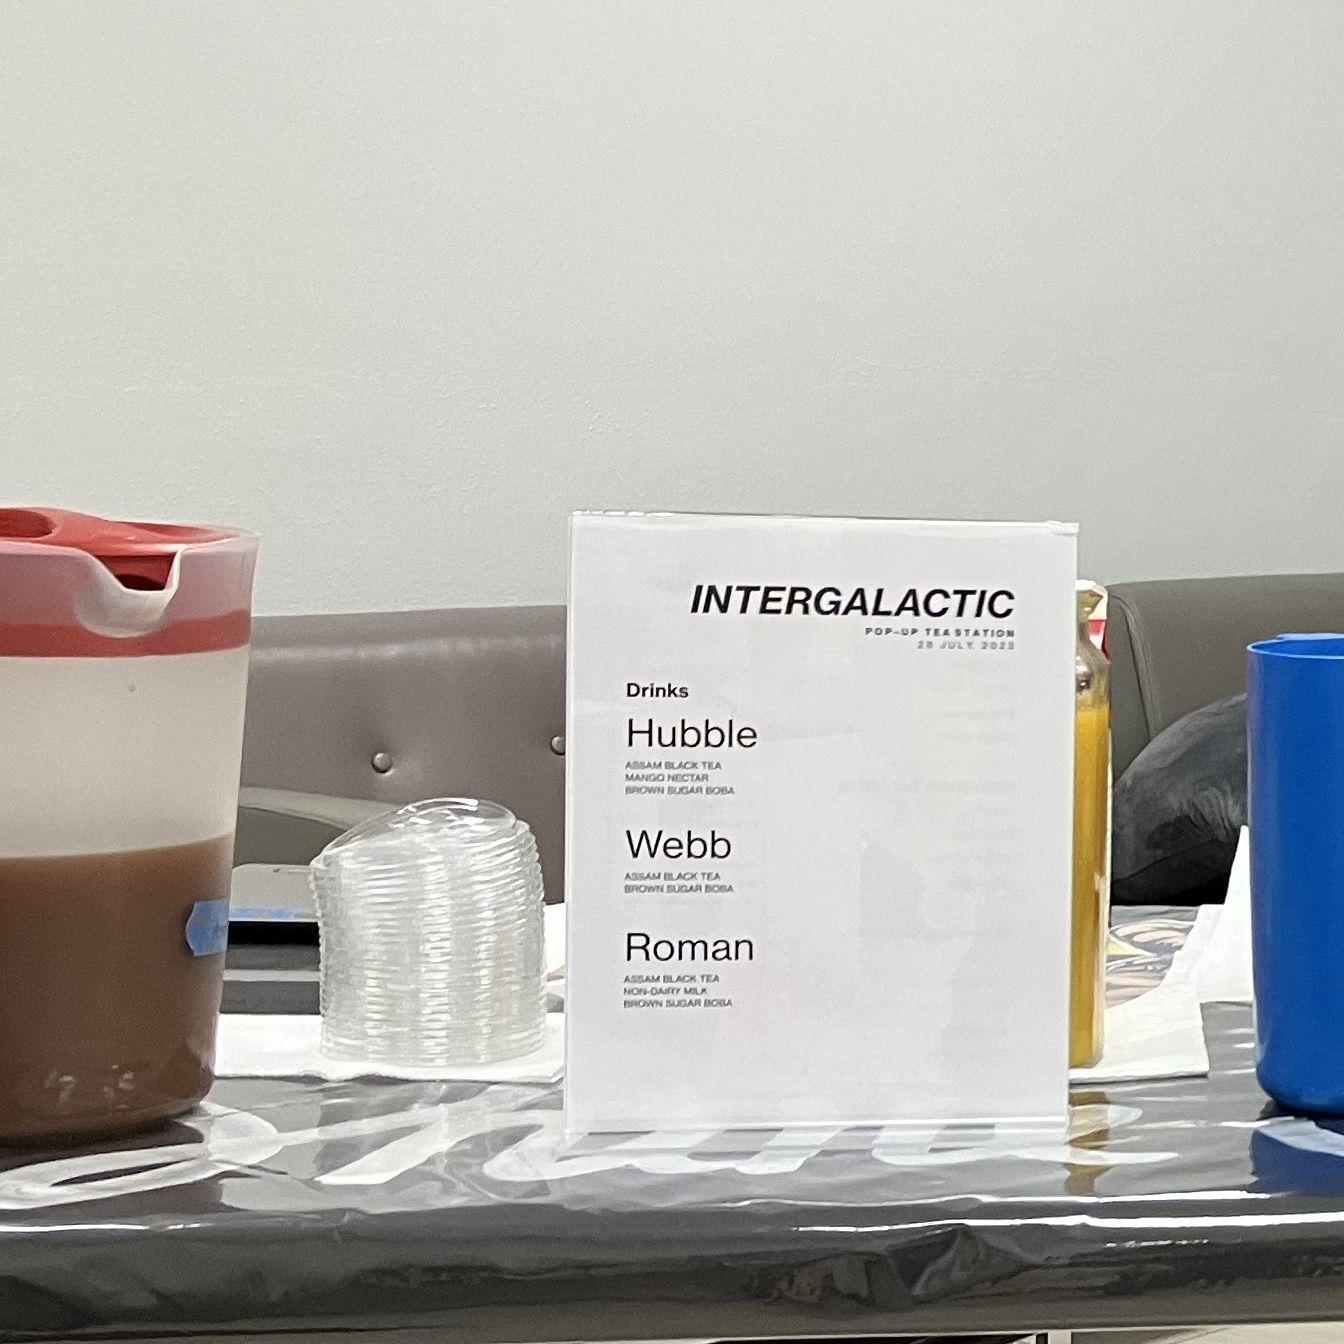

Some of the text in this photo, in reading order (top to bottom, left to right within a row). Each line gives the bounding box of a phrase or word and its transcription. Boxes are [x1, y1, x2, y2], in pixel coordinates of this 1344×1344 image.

[691, 585, 1015, 618] INTERGALACTIC
[865, 627, 1015, 638] POP-UP TEA STATION
[627, 683, 688, 698] Drinks
[628, 719, 757, 748] Hubble
[625, 761, 722, 770] ASSAM BLACK TEA
[625, 774, 709, 782] MANGO NECTAR
[625, 786, 665, 795] BROWN
[667, 786, 703, 795] SUGAR
[626, 830, 731, 859] Webb
[664, 872, 697, 881] BLACK
[700, 872, 721, 881] TEA
[624, 884, 664, 893] BROWN
[666, 884, 702, 893] SUGAR
[627, 933, 753, 961] Roman
[662, 974, 697, 983] BLACK
[700, 974, 720, 983] TEA
[683, 987, 708, 995] MILK
[623, 999, 663, 1009] BROWN
[665, 999, 702, 1008] SUGAR
